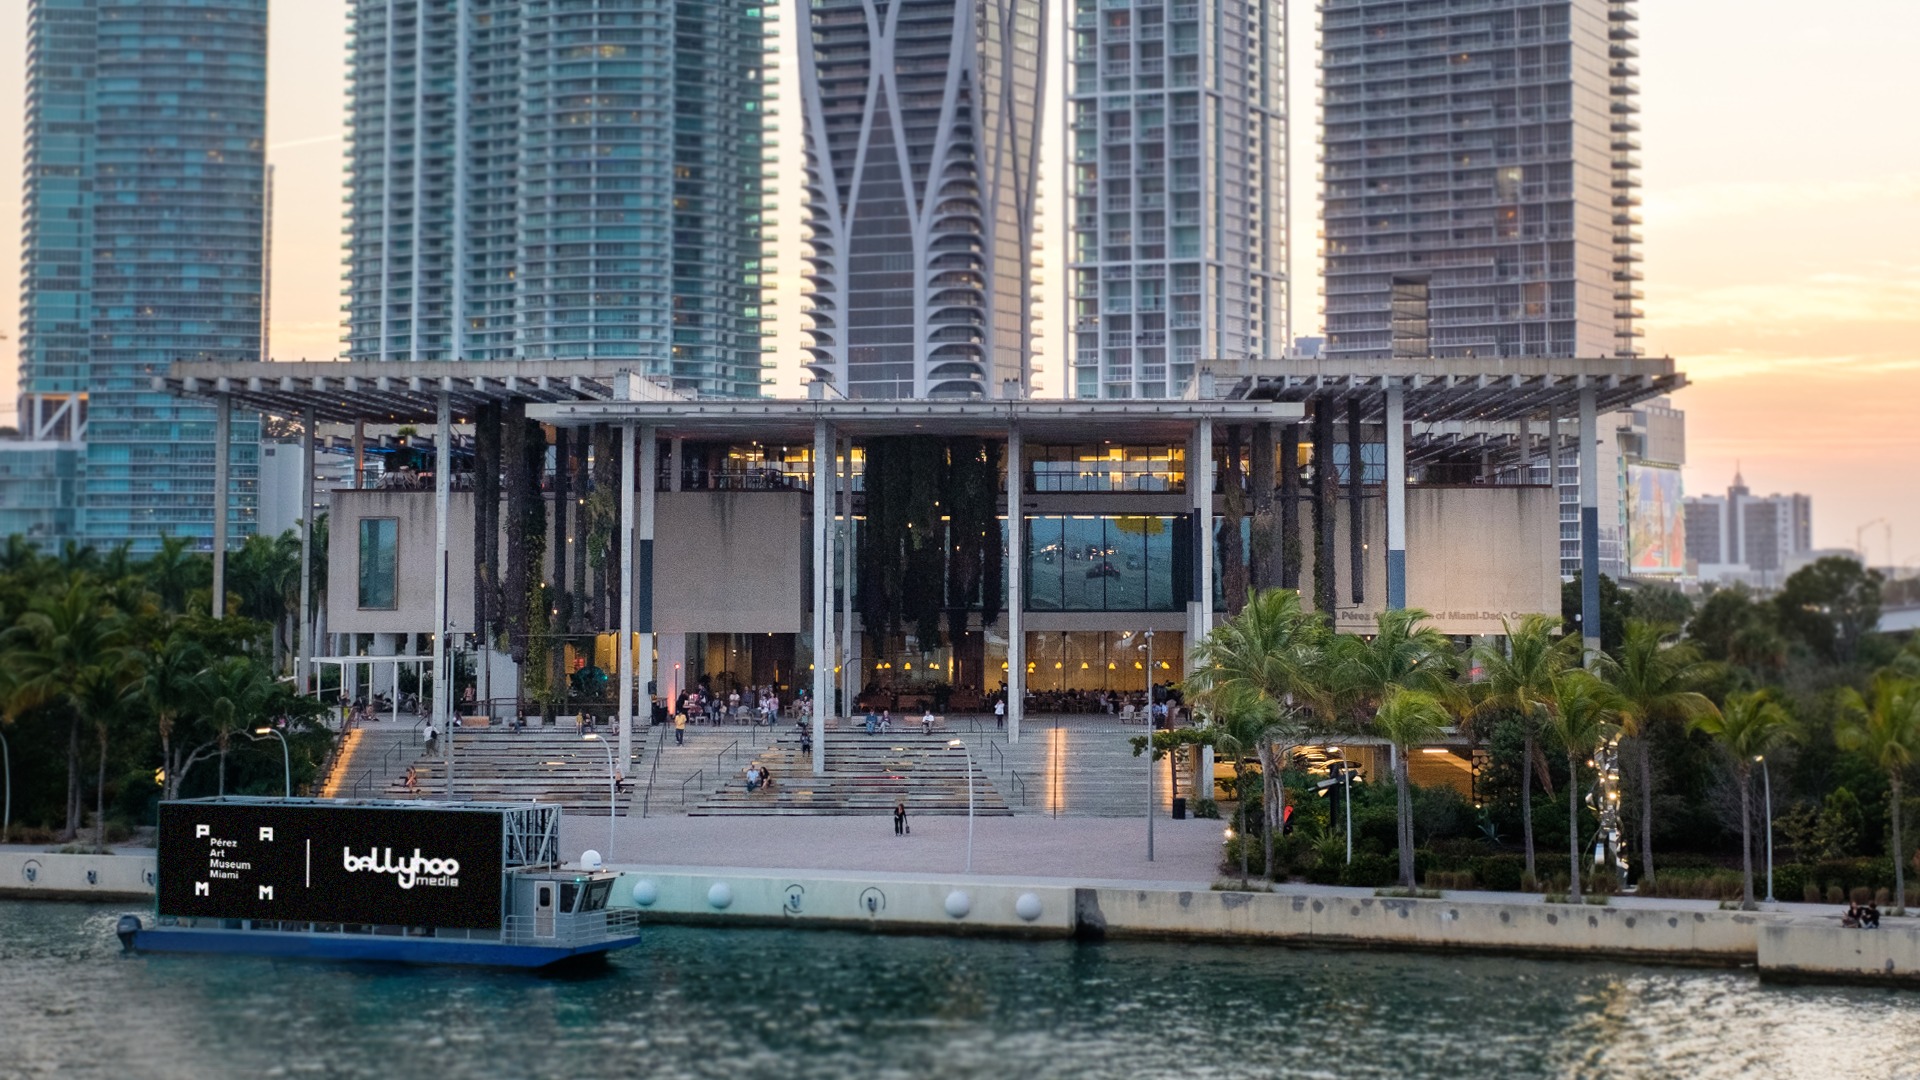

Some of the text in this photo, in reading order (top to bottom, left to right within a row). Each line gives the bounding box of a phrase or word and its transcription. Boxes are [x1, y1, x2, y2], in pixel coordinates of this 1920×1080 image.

[1341, 611, 1370, 621] Pérez
[1435, 611, 1446, 620] of
[196, 824, 273, 842] P A
[210, 838, 237, 847] Pérez
[210, 849, 225, 857] Art
[210, 859, 251, 870] Museum
[210, 870, 239, 879] Miami
[416, 876, 459, 887] media
[195, 881, 273, 900] M M
